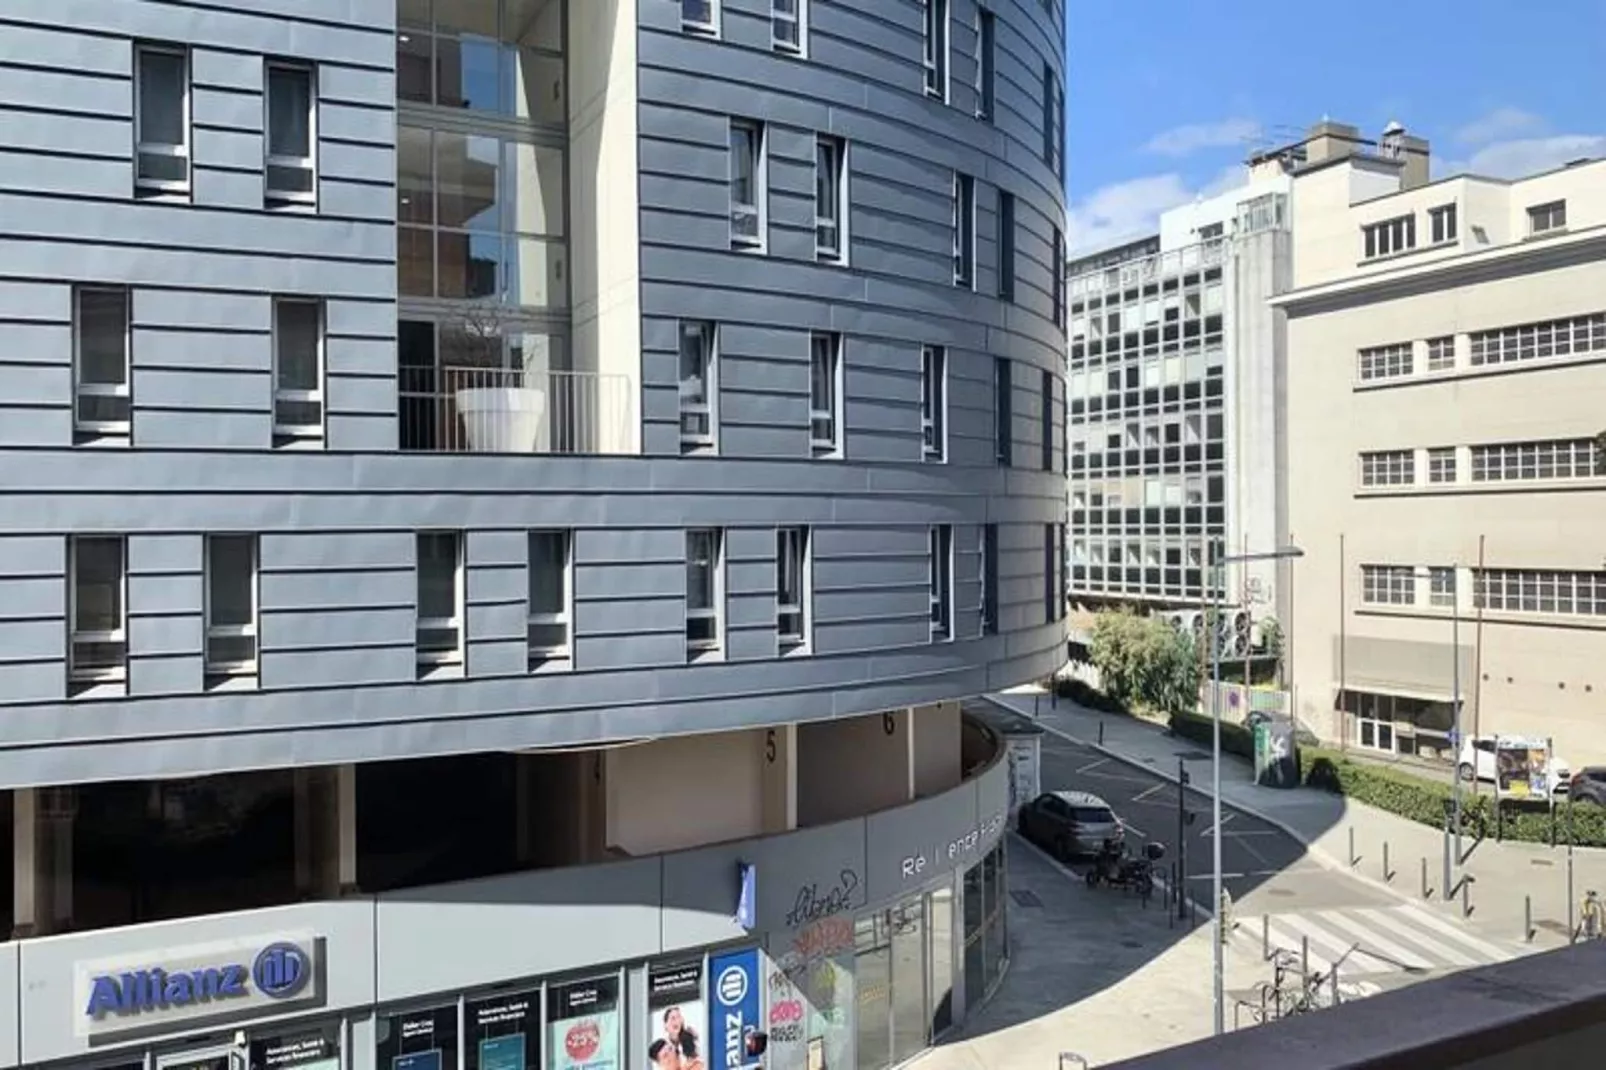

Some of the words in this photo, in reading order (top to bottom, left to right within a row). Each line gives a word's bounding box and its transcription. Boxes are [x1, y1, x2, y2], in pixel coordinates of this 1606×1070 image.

[882, 710, 895, 736] 6
[765, 730, 777, 763] 5
[86, 963, 248, 1018] Allianz
[725, 1010, 743, 1070] anz
